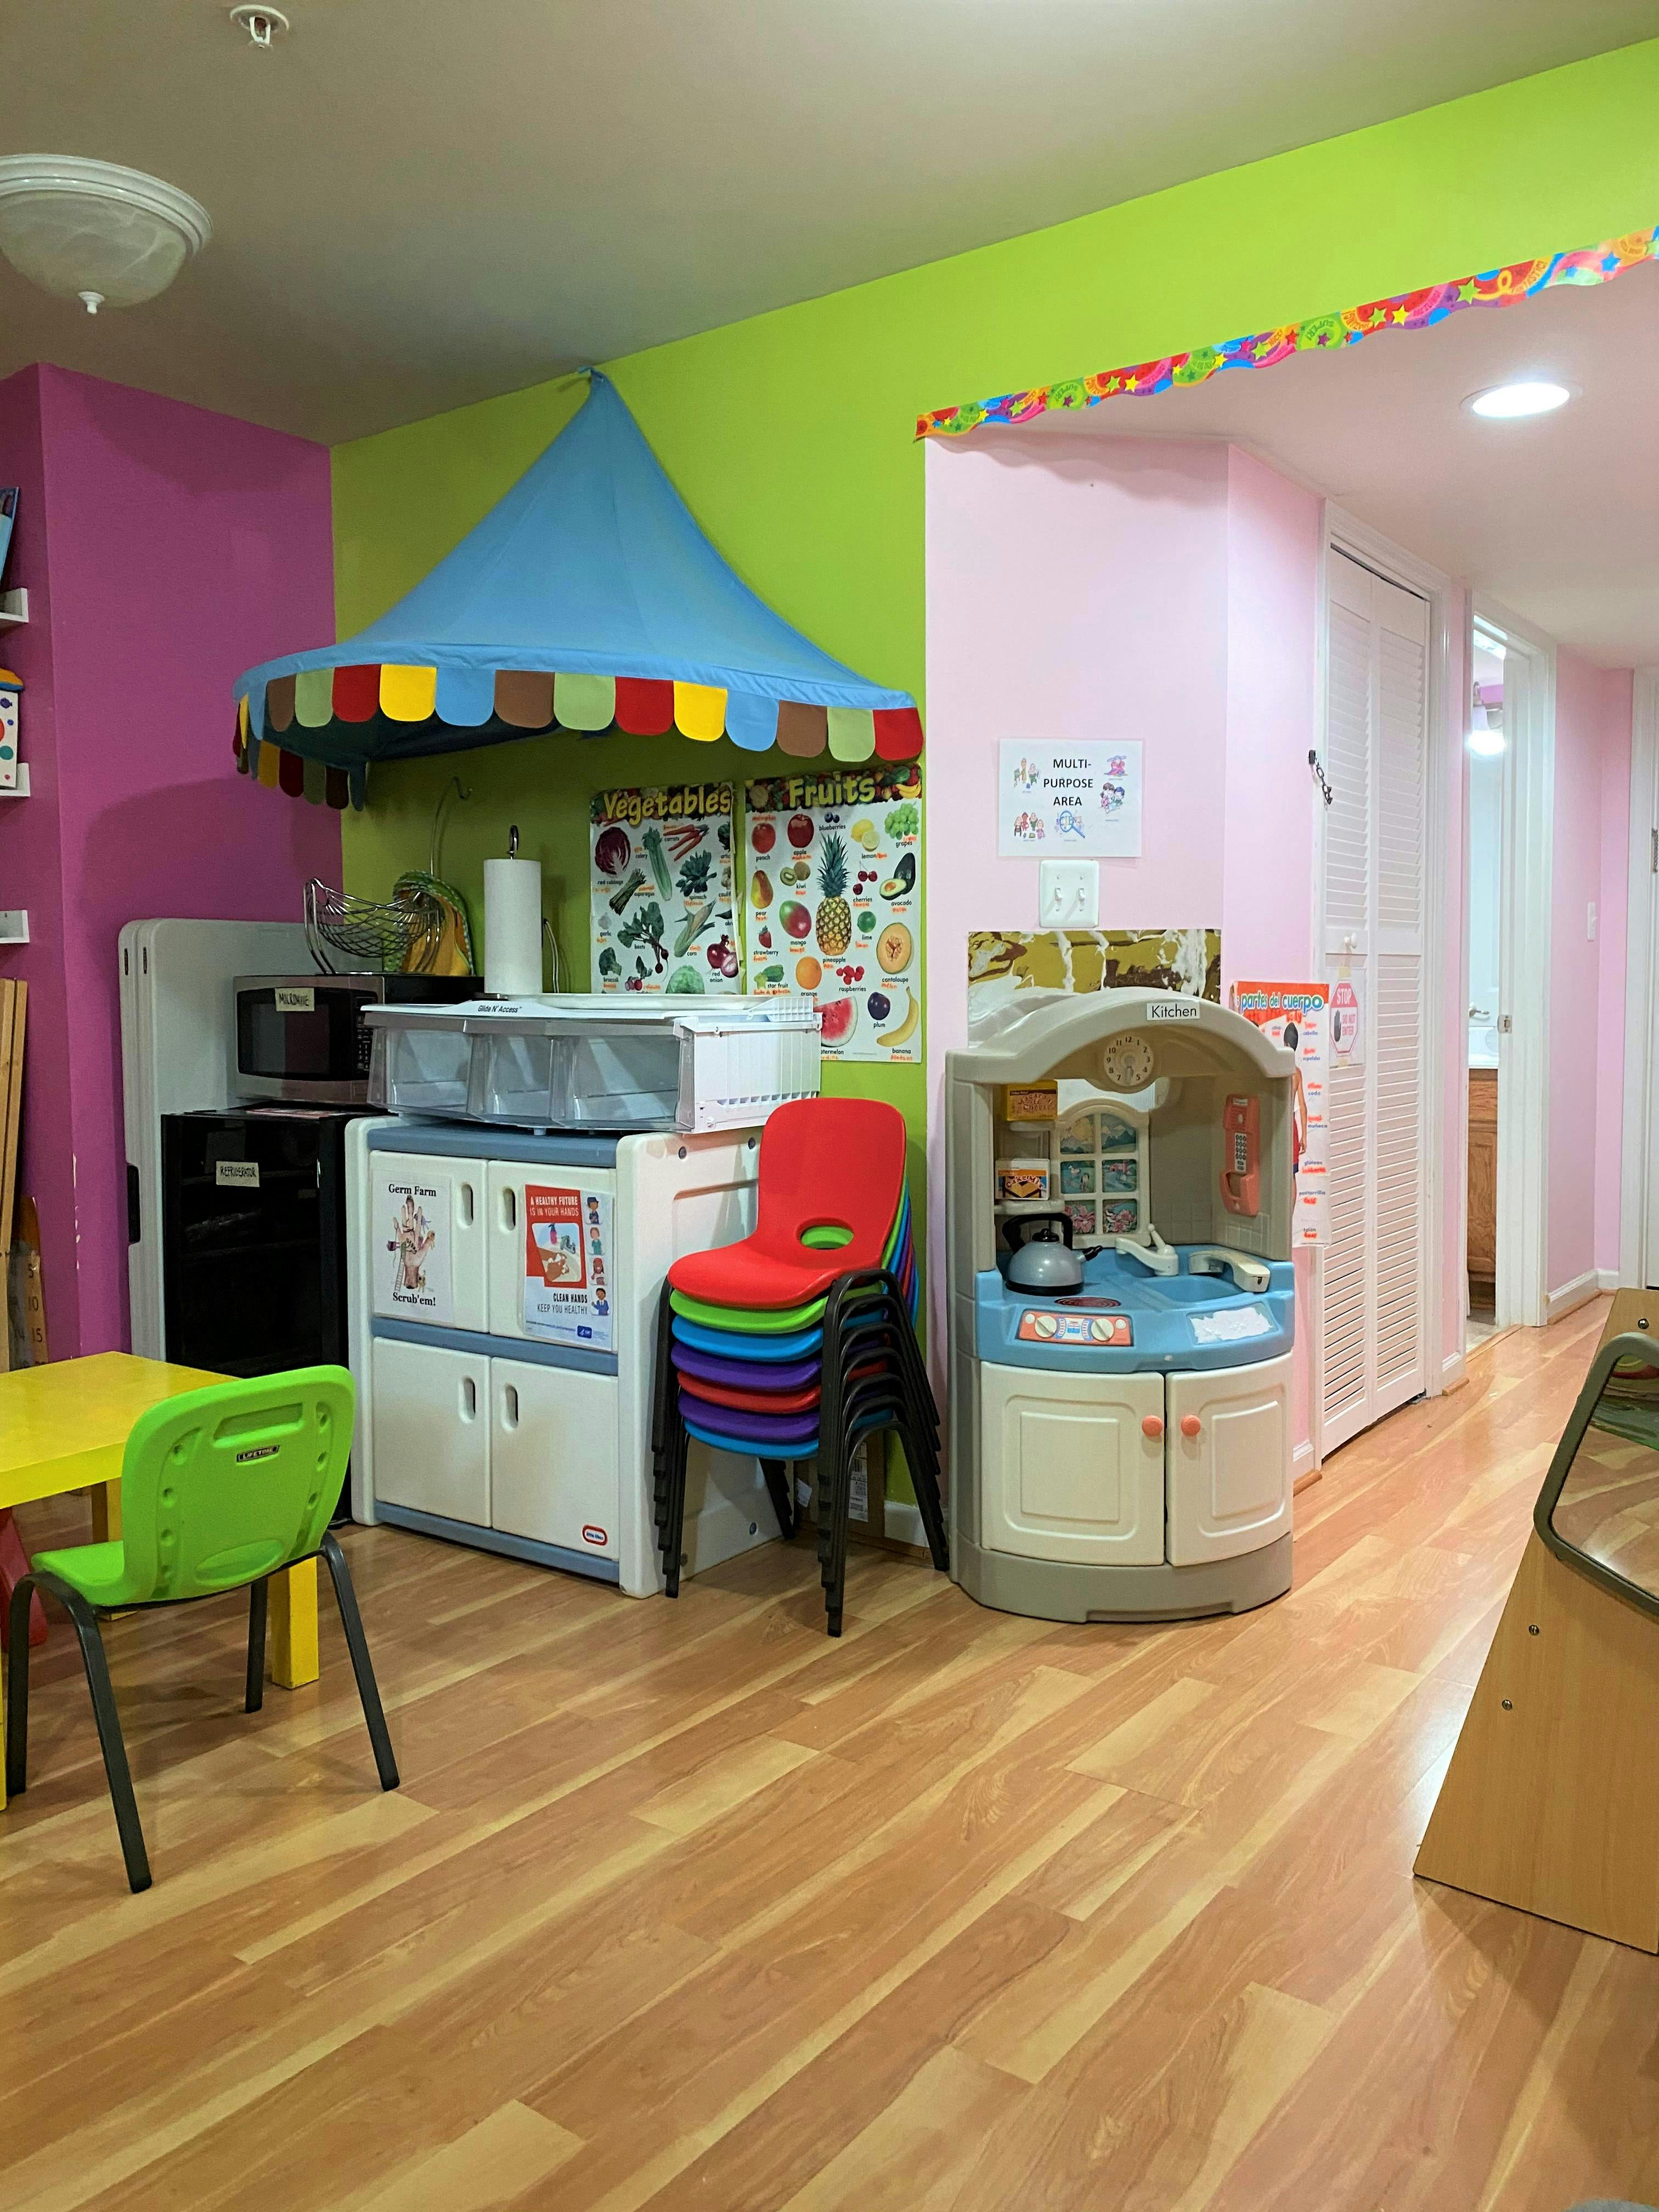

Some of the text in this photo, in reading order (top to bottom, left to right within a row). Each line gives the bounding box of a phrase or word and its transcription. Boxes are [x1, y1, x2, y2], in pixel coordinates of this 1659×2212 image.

[1053, 759, 1091, 769] MULTI-
[1043, 779, 1093, 788] PURPOSE
[789, 771, 876, 809] Fruits
[604, 786, 732, 826] Vegetables
[1053, 797, 1082, 806] AREA
[882, 976, 909, 984] cantaloupe
[839, 986, 866, 994] raspberries
[1337, 988, 1352, 1005] STOP
[1241, 990, 1325, 1017] partes del cuerpo
[1152, 1003, 1197, 1018] Kitchen
[1342, 1014, 1348, 1024] DO
[1342, 1026, 1354, 1036] ENTER
[388, 1183, 437, 1197] Germ Farm
[530, 1196, 578, 1206] A HEALTHY FUTURE
[529, 1207, 579, 1216] IS IN YOUR HANDS
[29, 1295, 39, 1311] 10
[393, 1291, 436, 1306] Scrub'em!
[553, 1293, 588, 1304] CLEAN HANDS
[537, 1304, 588, 1314] KEEP YOU HEALTHY
[32, 1327, 43, 1342] 15
